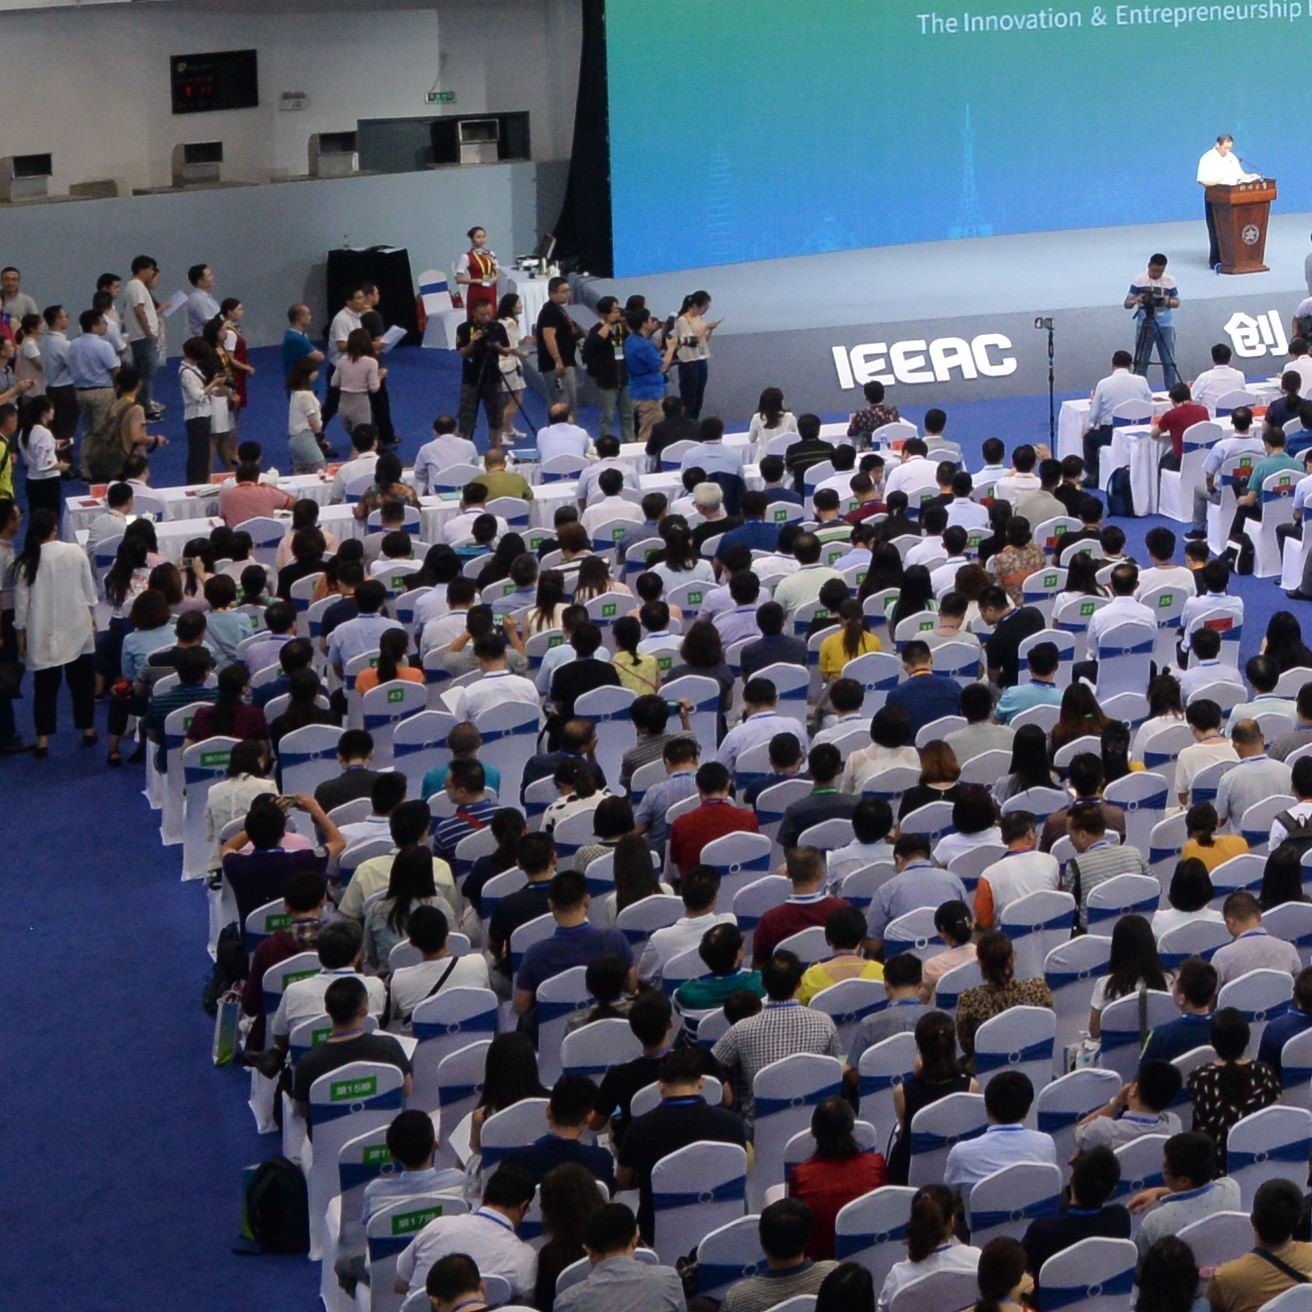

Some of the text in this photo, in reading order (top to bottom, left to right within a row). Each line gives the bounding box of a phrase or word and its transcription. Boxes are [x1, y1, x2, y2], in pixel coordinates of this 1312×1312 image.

[916, 13, 958, 34] The
[964, 7, 1081, 32] Innovation
[1091, 7, 1107, 26] &
[832, 333, 1018, 389] IEEAC
